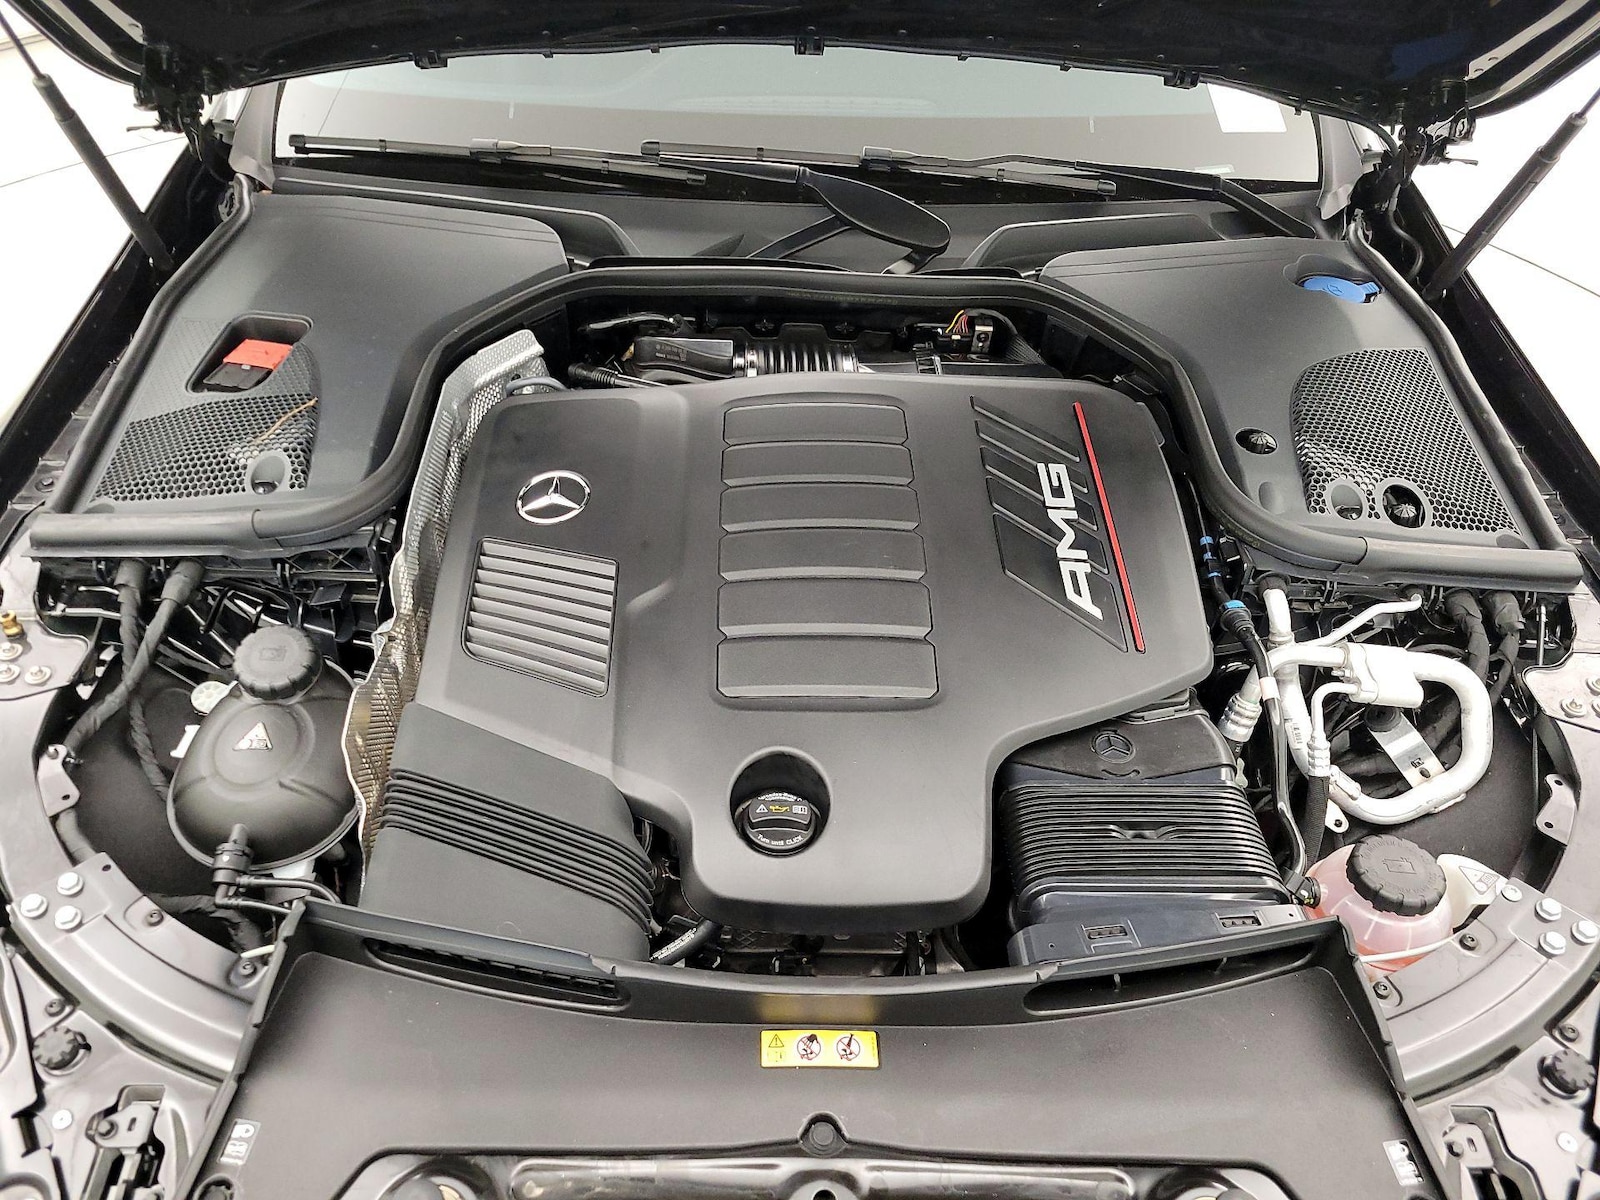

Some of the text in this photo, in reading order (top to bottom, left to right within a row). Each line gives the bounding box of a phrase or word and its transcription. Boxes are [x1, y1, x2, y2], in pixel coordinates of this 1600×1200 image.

[1037, 462, 1103, 621] AMG
[758, 834, 769, 843] Turn
[786, 835, 803, 845] CLICK
